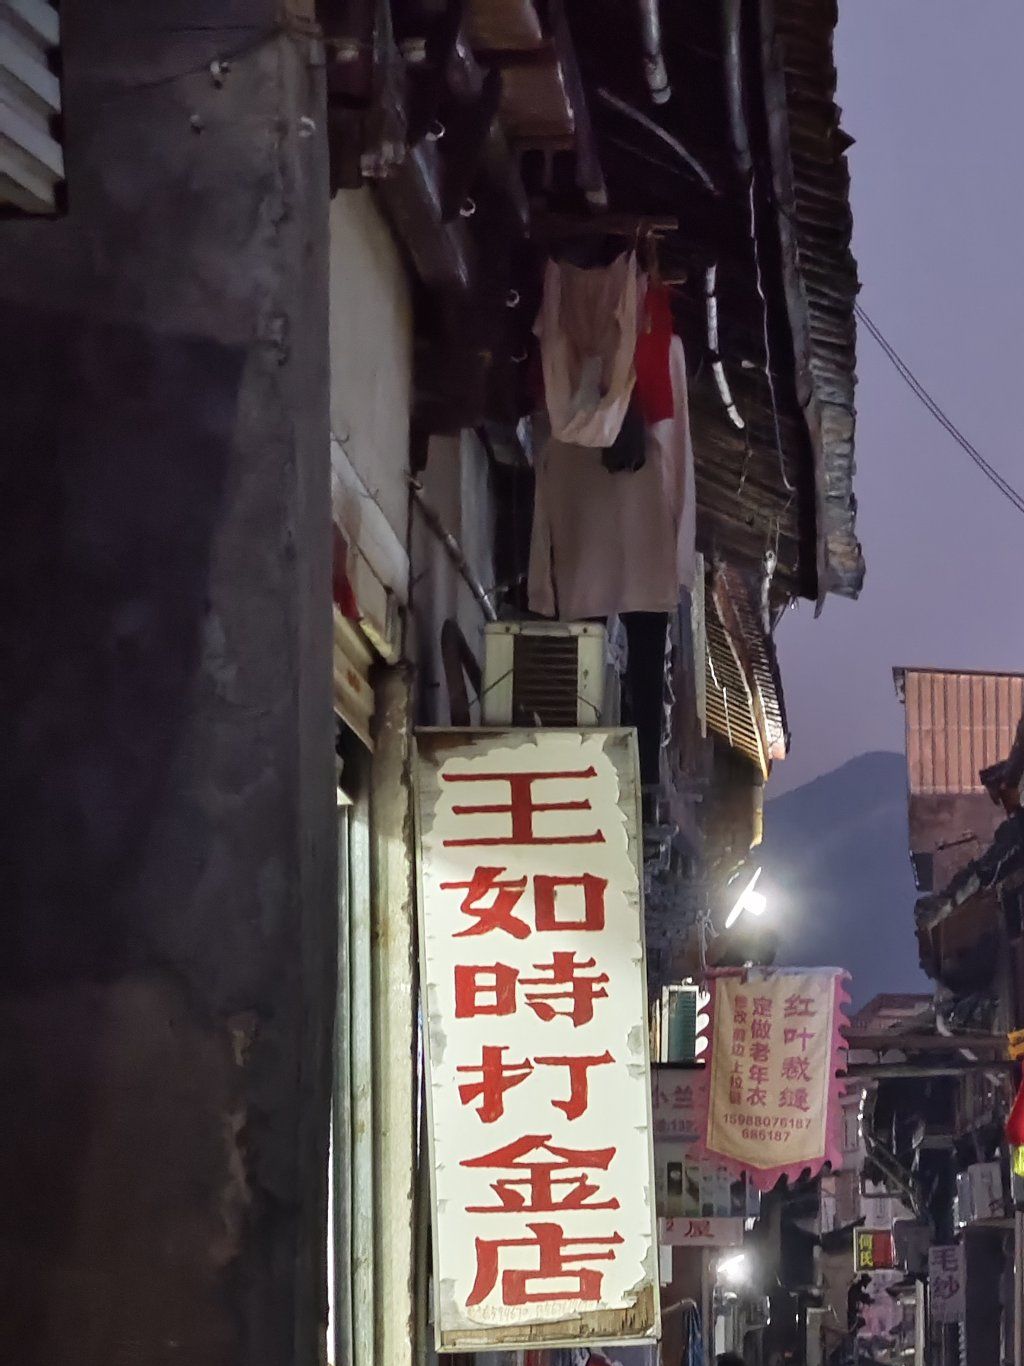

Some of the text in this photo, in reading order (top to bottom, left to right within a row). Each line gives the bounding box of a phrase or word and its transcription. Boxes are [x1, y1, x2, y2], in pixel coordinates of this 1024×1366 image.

[440, 765, 624, 1307] 王如時打金店
[723, 1112, 812, 1130] 15988076187
